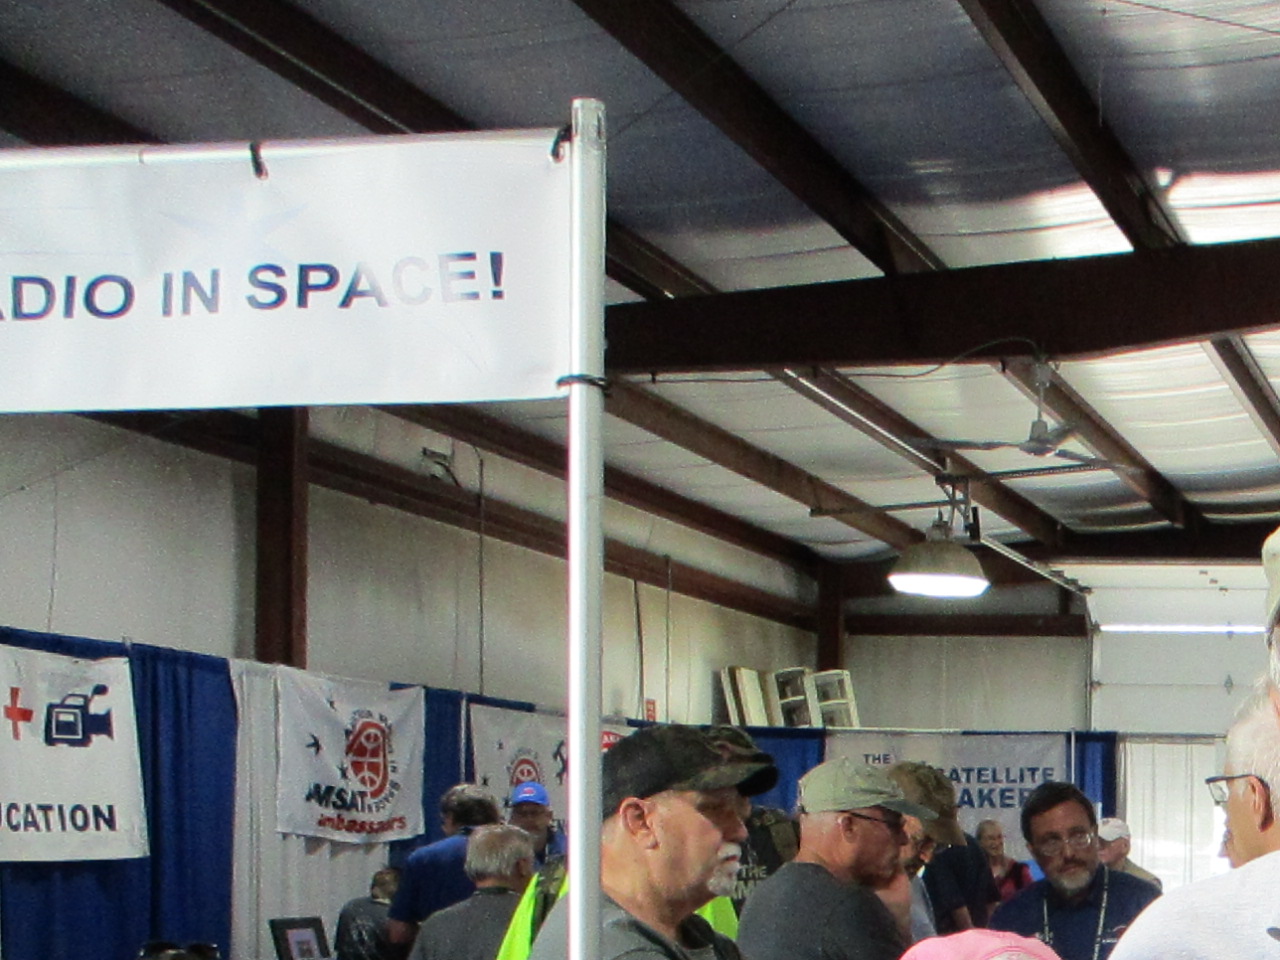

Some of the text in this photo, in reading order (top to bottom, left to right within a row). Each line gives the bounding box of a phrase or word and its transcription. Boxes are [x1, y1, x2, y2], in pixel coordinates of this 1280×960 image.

[0, 251, 505, 320] DIO IN SPACE!
[864, 753, 892, 765] THE
[0, 802, 118, 832] CATION
